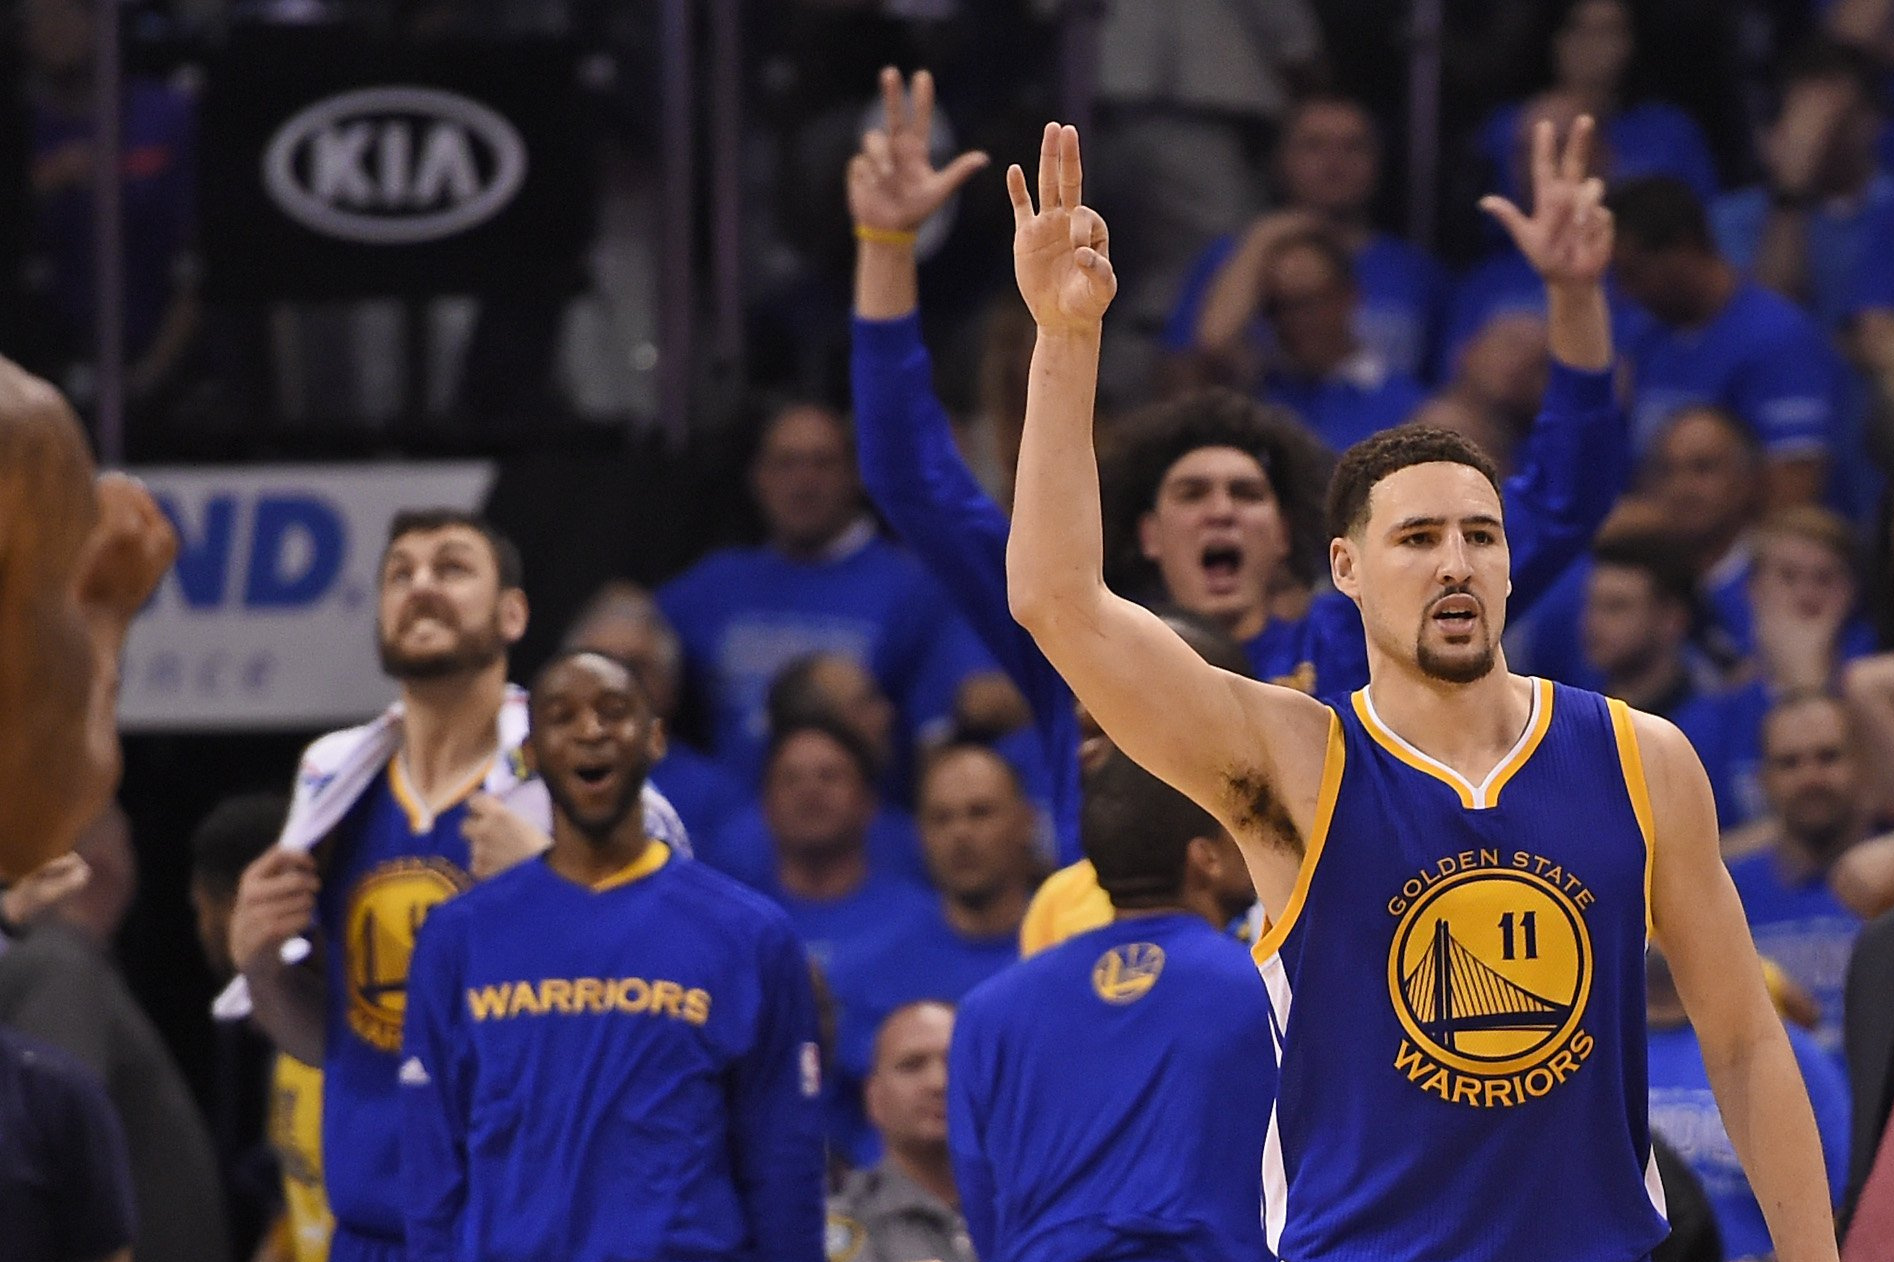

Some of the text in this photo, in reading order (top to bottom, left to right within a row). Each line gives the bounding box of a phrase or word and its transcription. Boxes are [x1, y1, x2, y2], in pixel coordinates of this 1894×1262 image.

[312, 119, 483, 204] KIA
[1387, 848, 1596, 916] GOLDEN STATE
[1498, 910, 1539, 961] 11
[467, 976, 712, 1027] WARRIORS
[1393, 1028, 1596, 1108] WARRIORS
